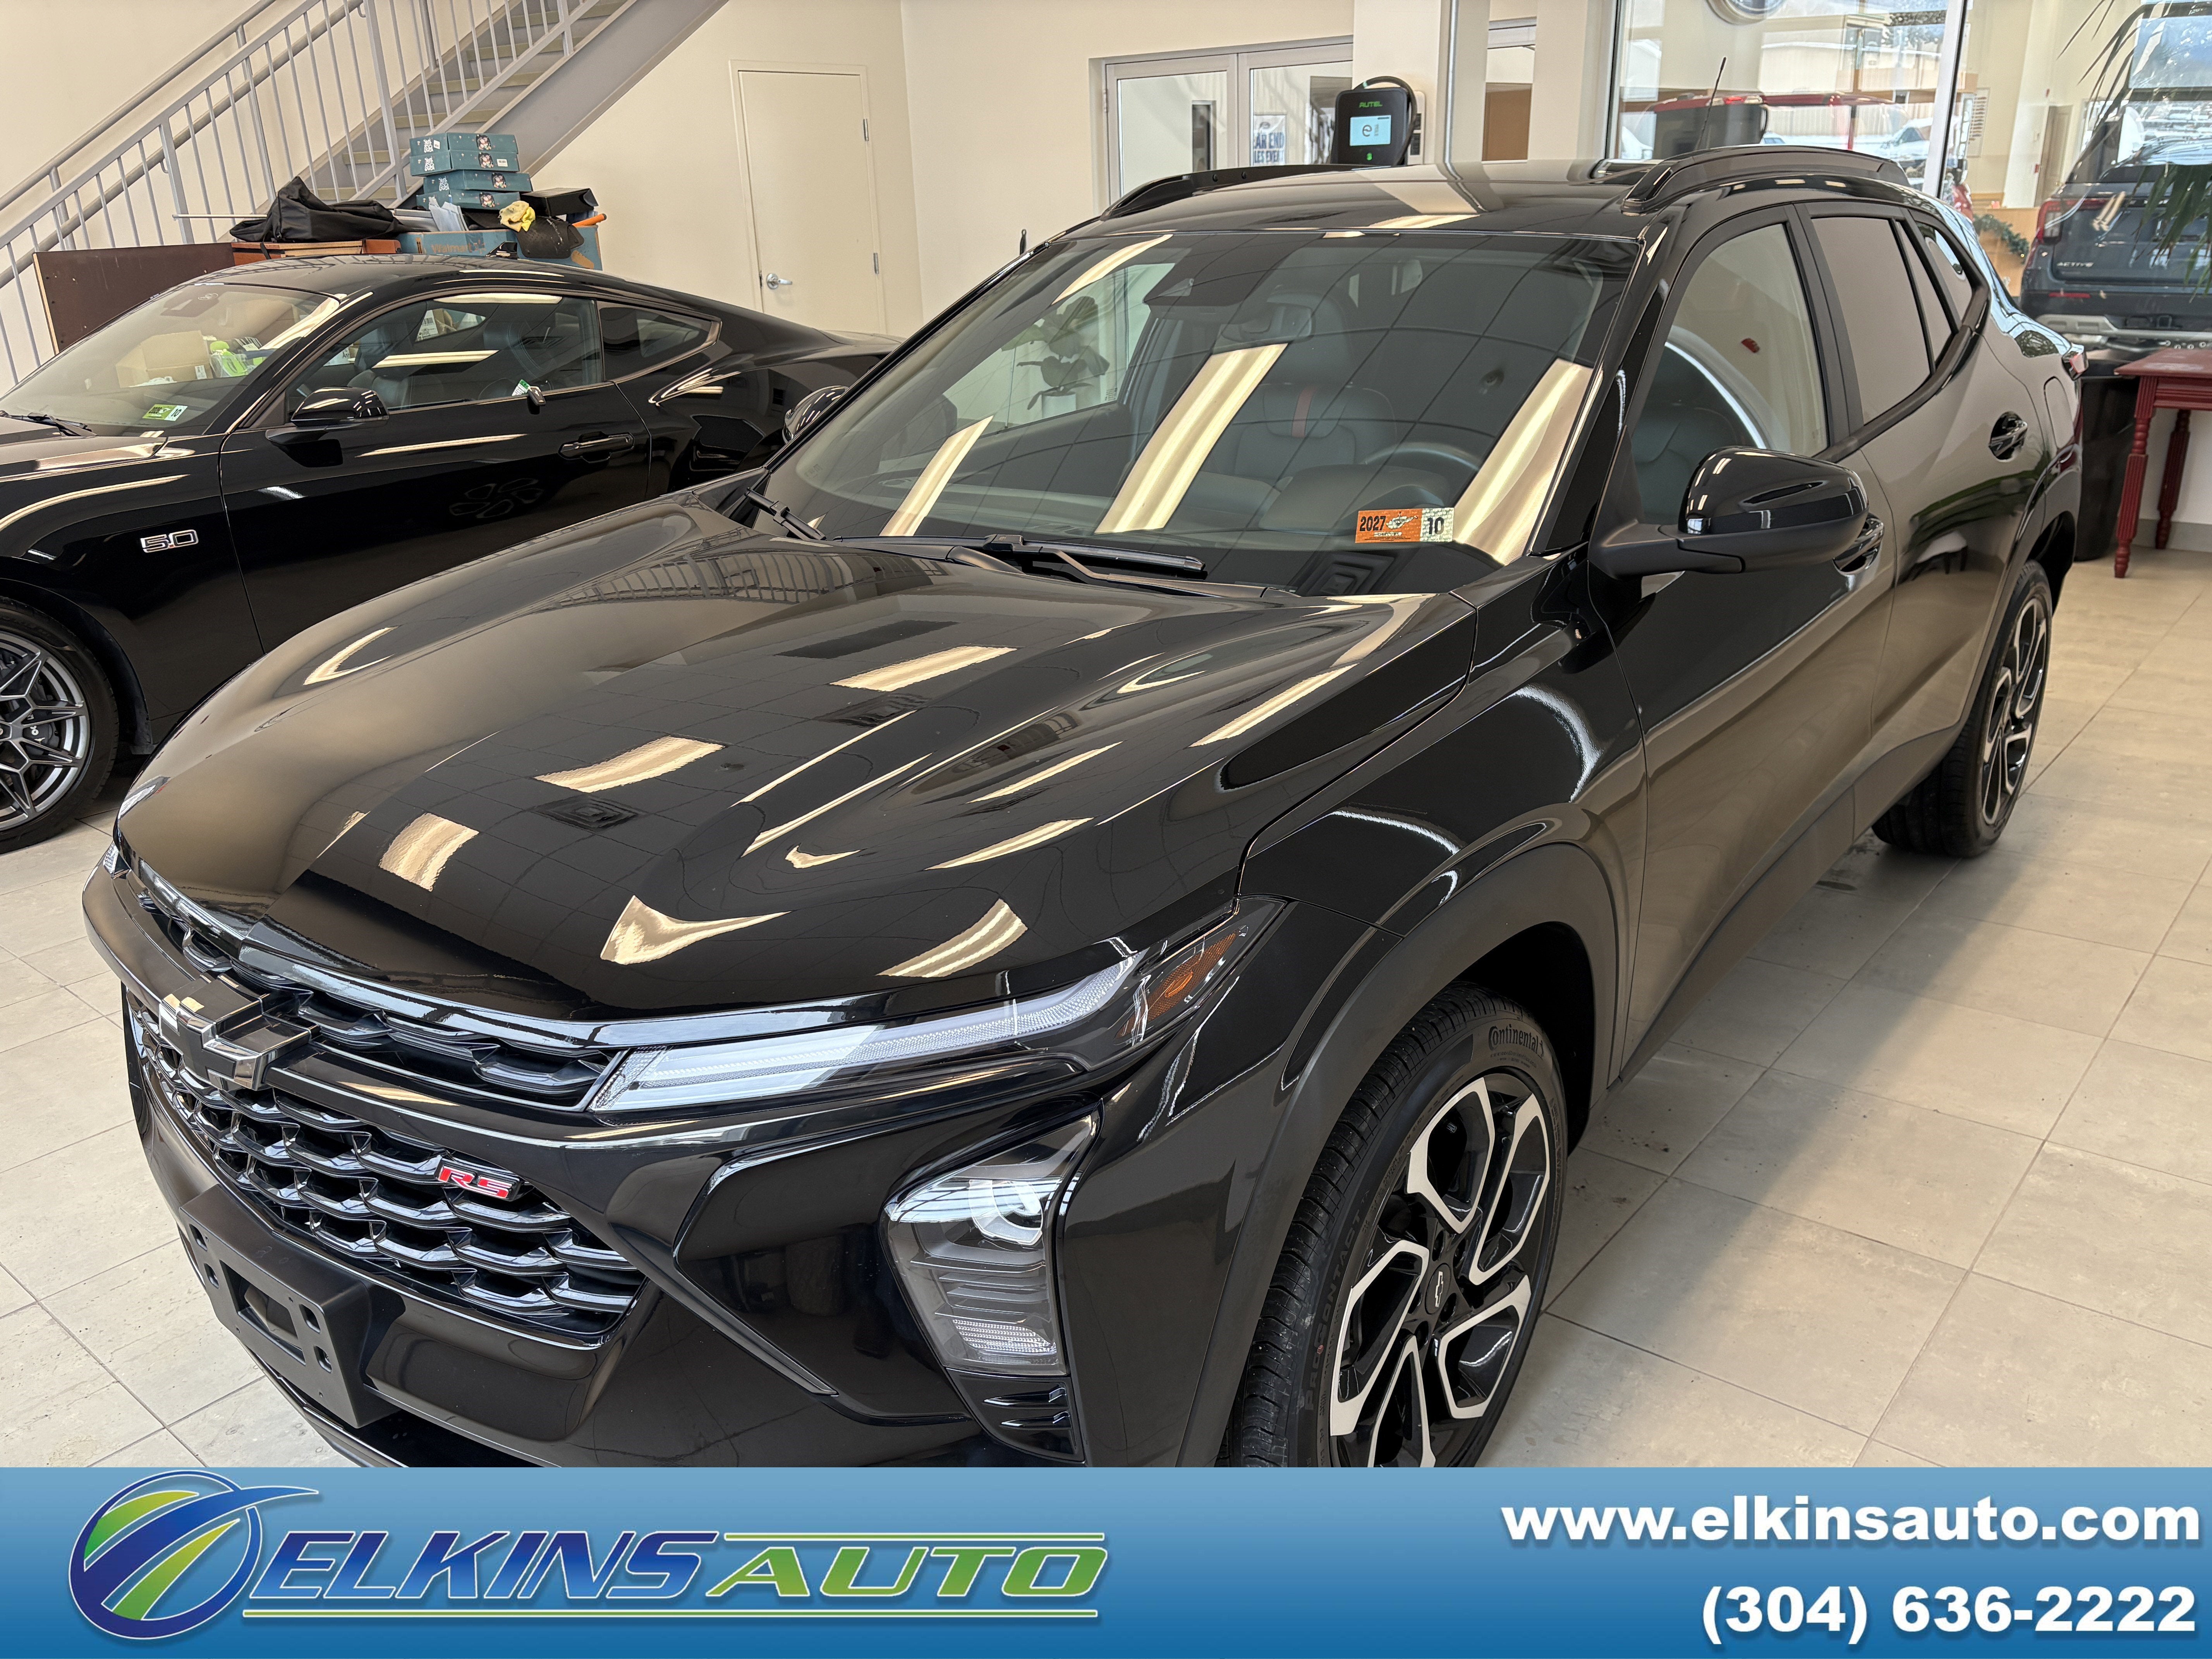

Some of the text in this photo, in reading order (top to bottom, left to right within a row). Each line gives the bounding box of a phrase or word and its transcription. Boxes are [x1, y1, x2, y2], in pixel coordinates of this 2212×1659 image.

[171, 409, 182, 417] 10
[1359, 515, 1444, 535] 2027 10
[140, 529, 199, 553] 5.0
[1489, 1024, 1539, 1054] Continental
[438, 1165, 512, 1199] RS
